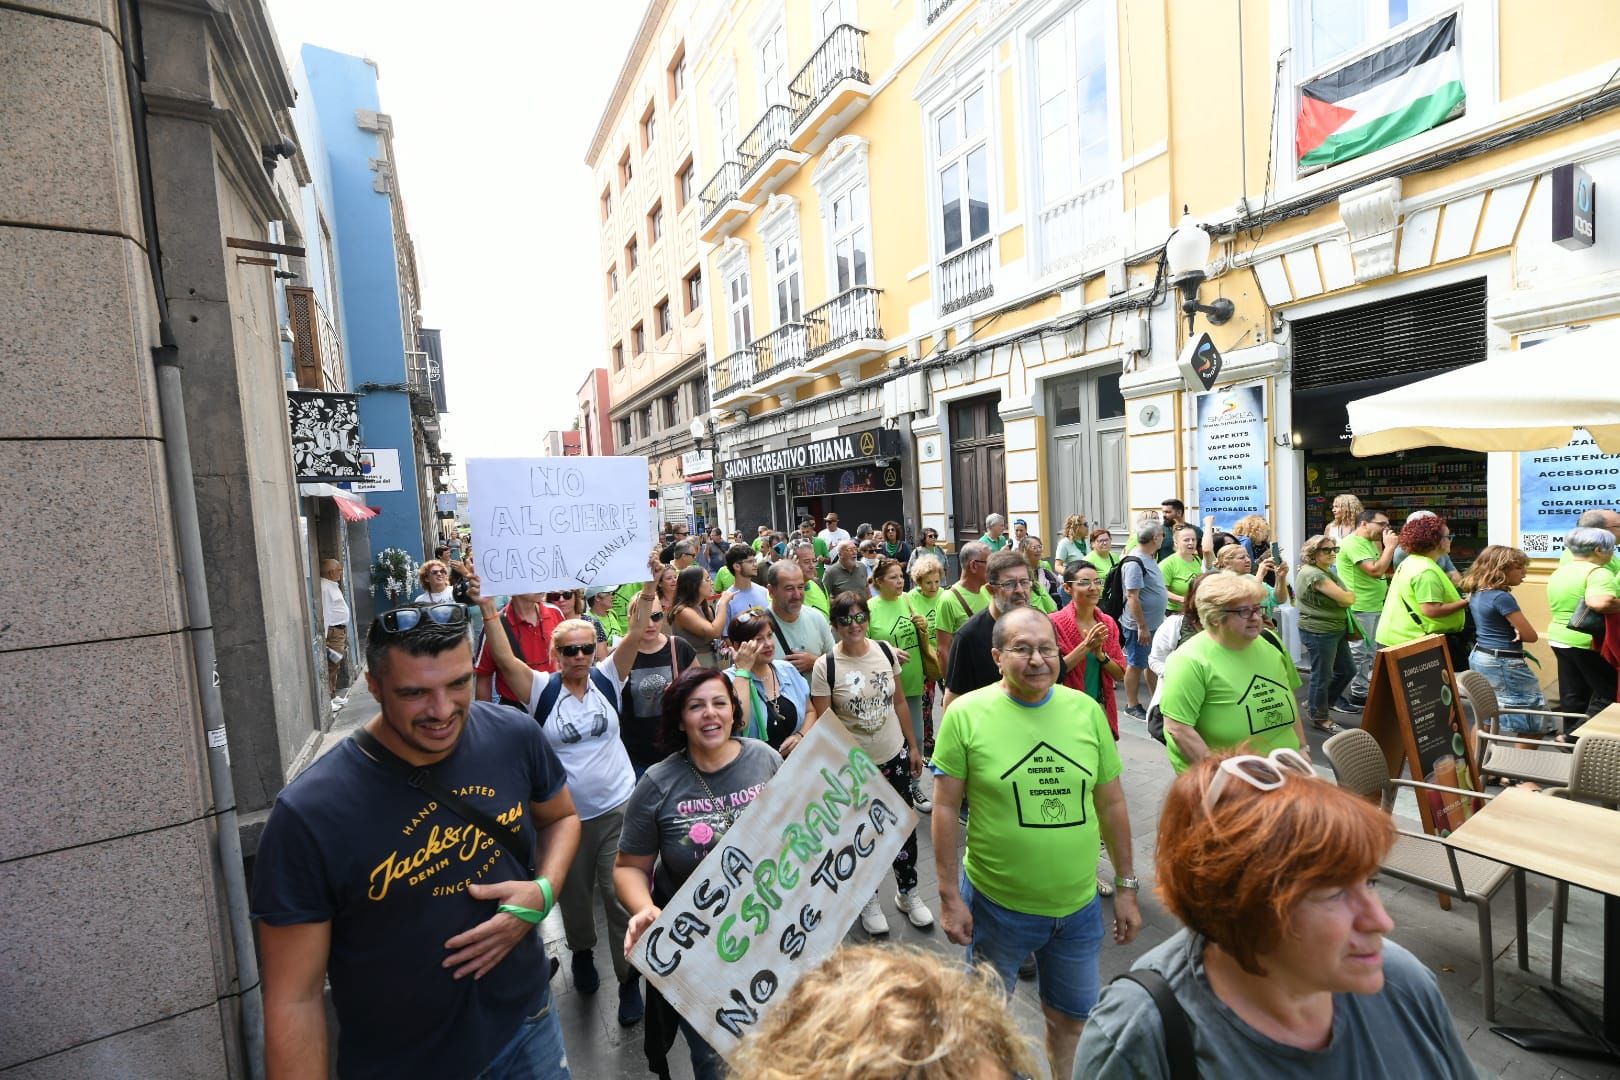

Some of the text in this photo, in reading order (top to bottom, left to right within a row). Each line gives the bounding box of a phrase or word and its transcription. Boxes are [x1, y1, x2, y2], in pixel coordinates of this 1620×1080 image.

[724, 436, 855, 479] SALON RECREATIVO TRIANA
[530, 466, 585, 498] NO
[1549, 483, 1617, 492] LIQUIDOS
[490, 502, 638, 538] AL CIERRE
[482, 527, 638, 586] CASA ESPERANZA
[1046, 755, 1055, 763] AL
[677, 797, 714, 815] GUNS
[1029, 788, 1072, 796] ESPERANZA
[402, 800, 438, 836] HAND
[408, 857, 450, 887] DENIM
[432, 849, 501, 897] SINCE 1990
[716, 747, 878, 963] ESPERANZA
[645, 845, 753, 977] CASA
[715, 798, 899, 1039] NO SE TOCA
